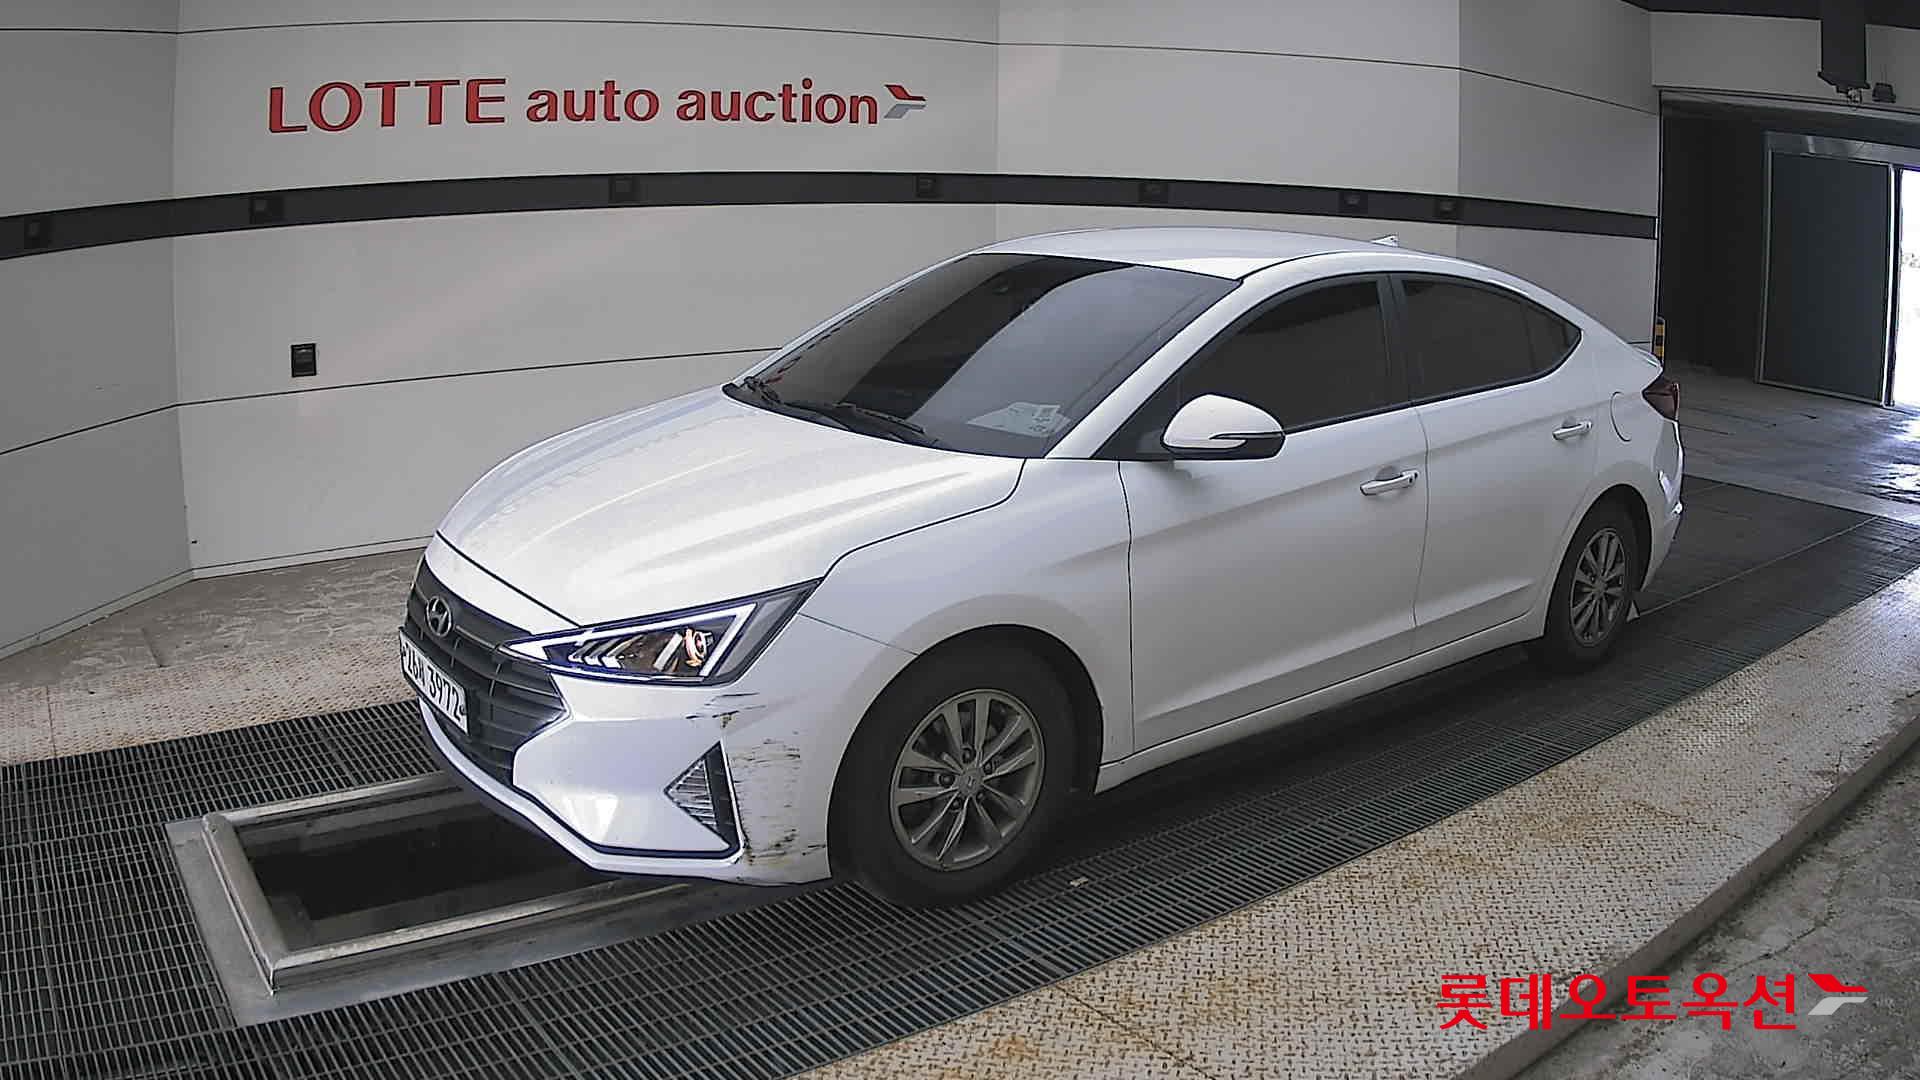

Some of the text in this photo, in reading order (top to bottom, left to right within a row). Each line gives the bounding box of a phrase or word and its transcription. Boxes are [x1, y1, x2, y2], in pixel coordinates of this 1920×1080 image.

[268, 78, 879, 133] LOTTE auto auction
[427, 665, 461, 722] 3972
